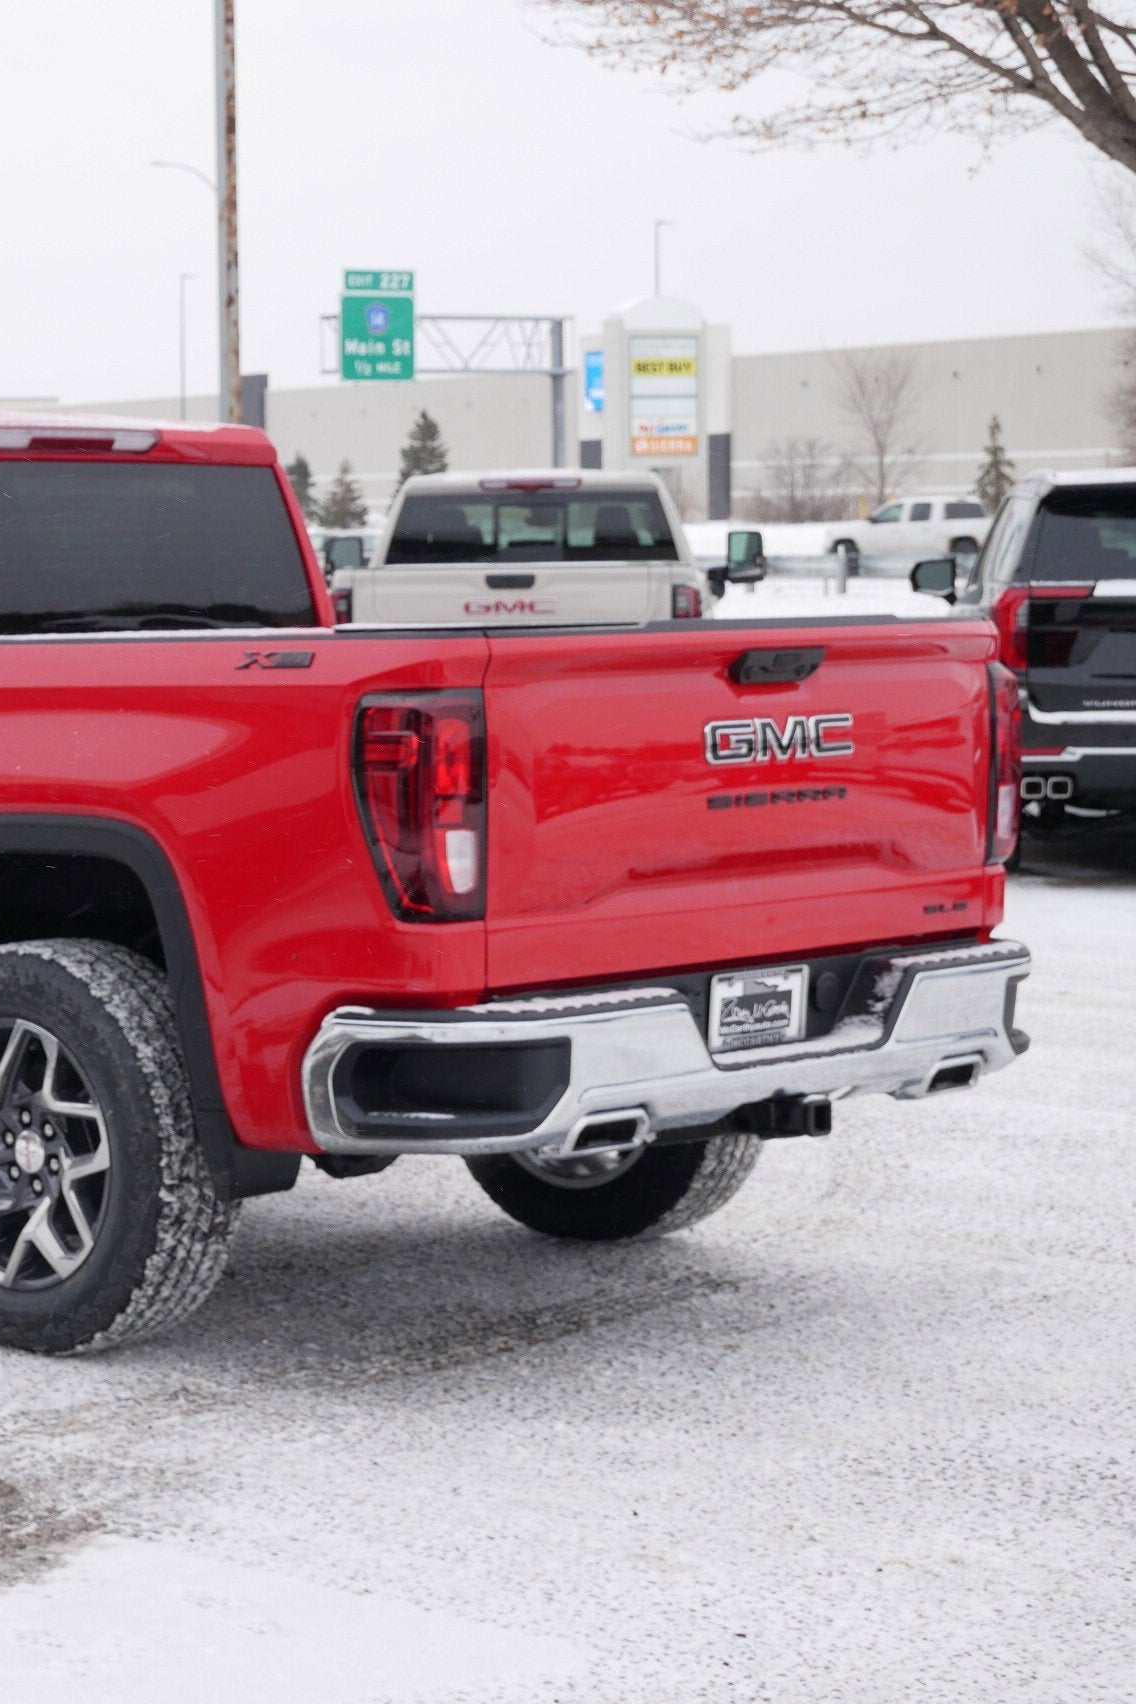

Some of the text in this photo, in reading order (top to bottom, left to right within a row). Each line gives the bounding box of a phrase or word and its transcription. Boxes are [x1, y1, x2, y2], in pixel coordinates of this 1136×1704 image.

[348, 272, 411, 289] EXIT 227
[344, 338, 411, 356] Main St
[635, 361, 692, 372] BEST BUY
[649, 441, 692, 452] SIERRA
[464, 598, 556, 614] GMC
[704, 712, 855, 765] GMC
[707, 786, 847, 810] SIERRA
